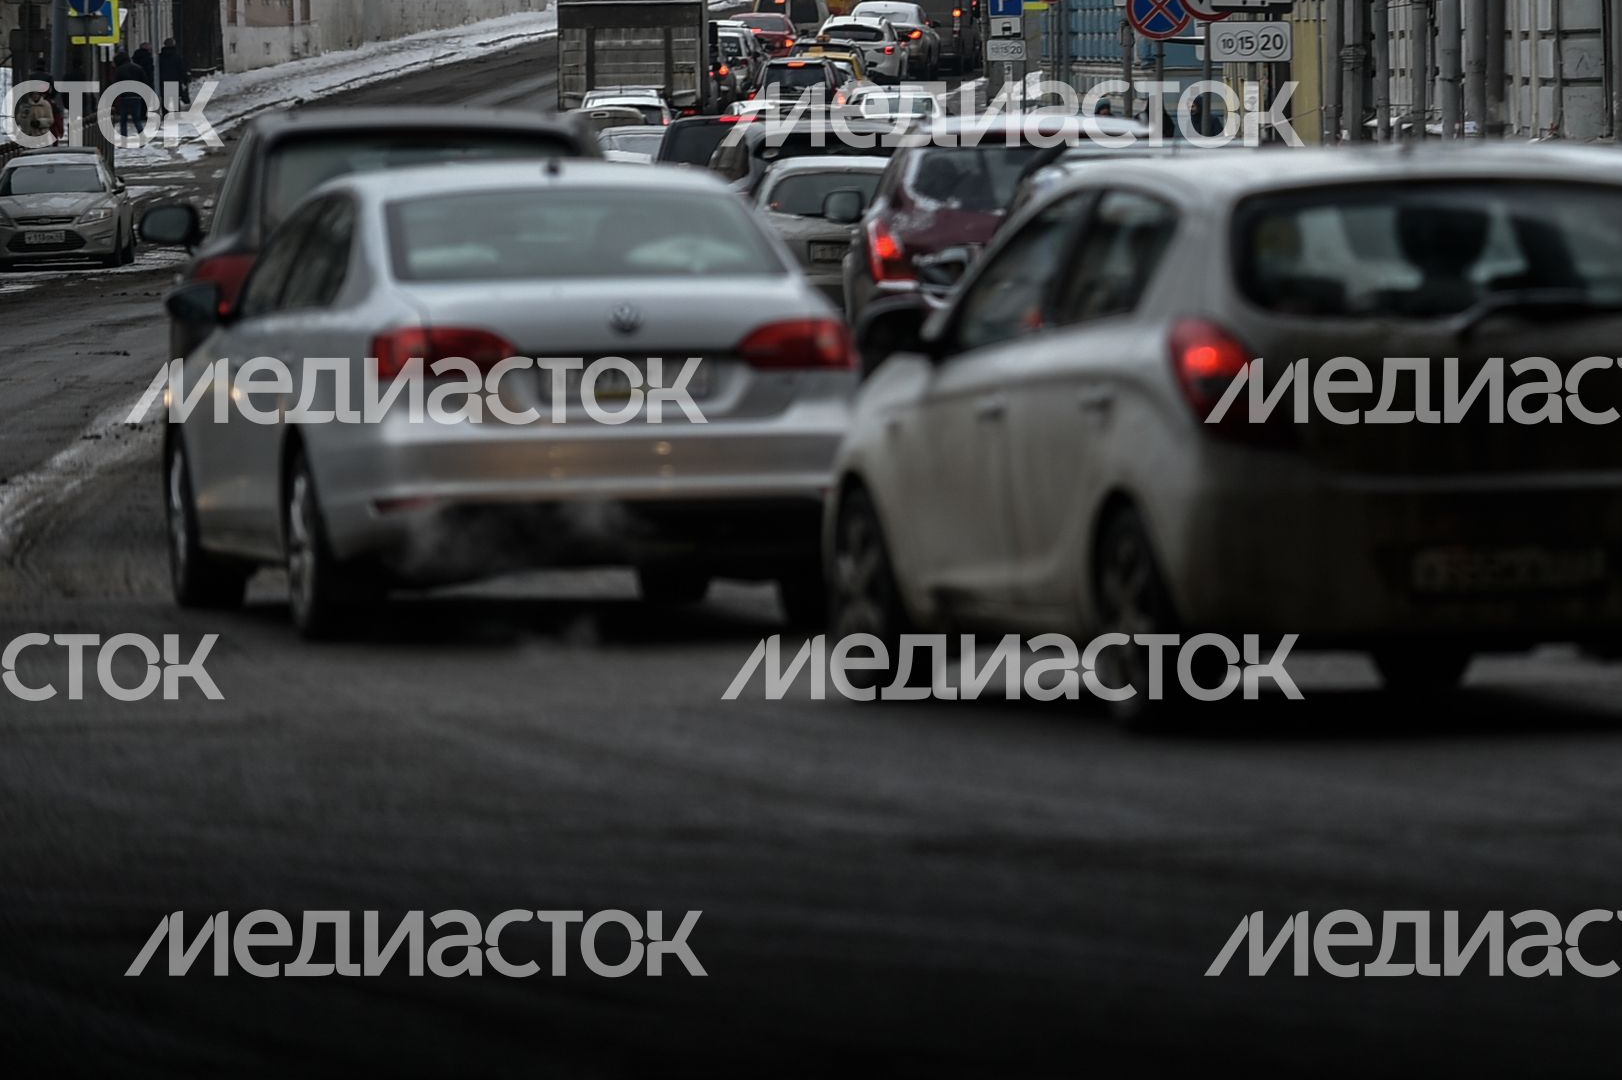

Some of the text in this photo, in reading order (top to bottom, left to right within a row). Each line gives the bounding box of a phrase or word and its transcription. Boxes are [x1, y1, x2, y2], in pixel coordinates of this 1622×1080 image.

[1221, 33, 1284, 51] 10 15 20
[1010, 45, 1023, 55] 20
